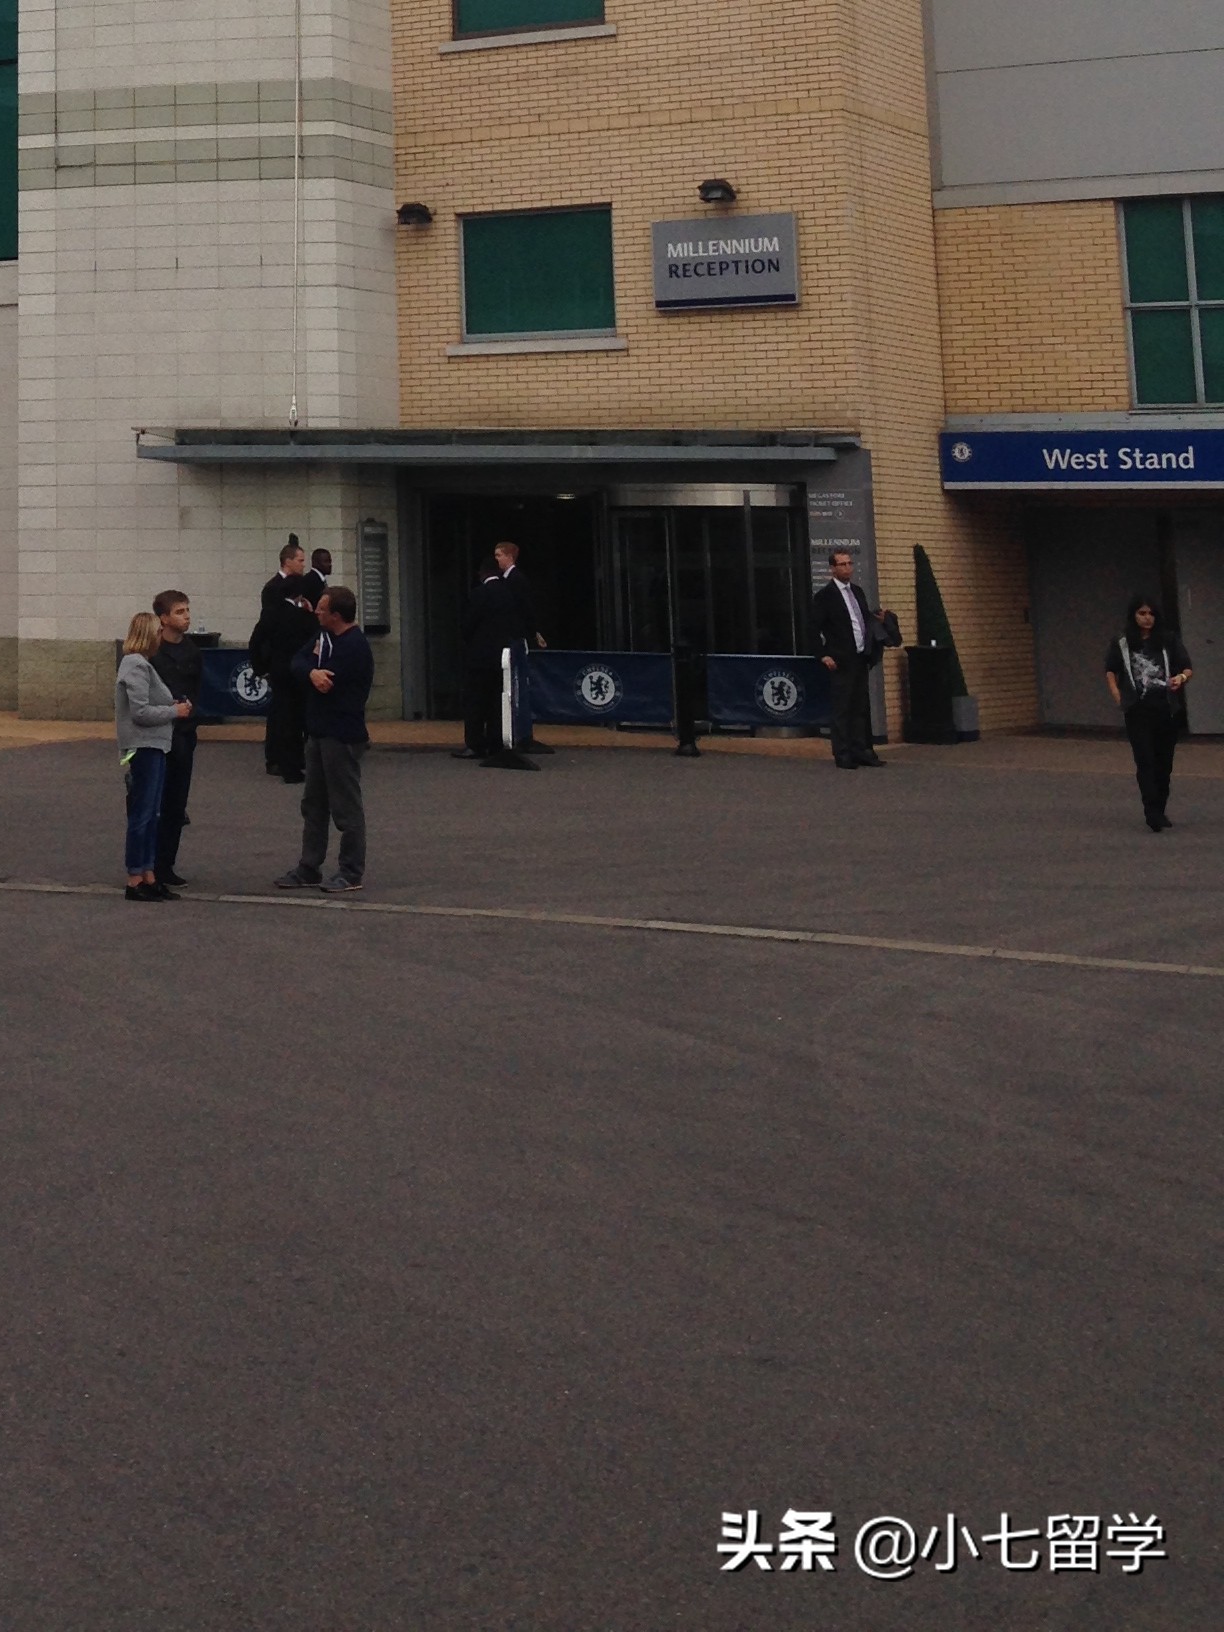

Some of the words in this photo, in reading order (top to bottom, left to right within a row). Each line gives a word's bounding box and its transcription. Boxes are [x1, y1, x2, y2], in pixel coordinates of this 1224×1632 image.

[667, 236, 780, 258] MILLENNIUM
[668, 257, 781, 279] RECEPTION
[1042, 448, 1109, 470] West
[1117, 446, 1195, 470] Stand
